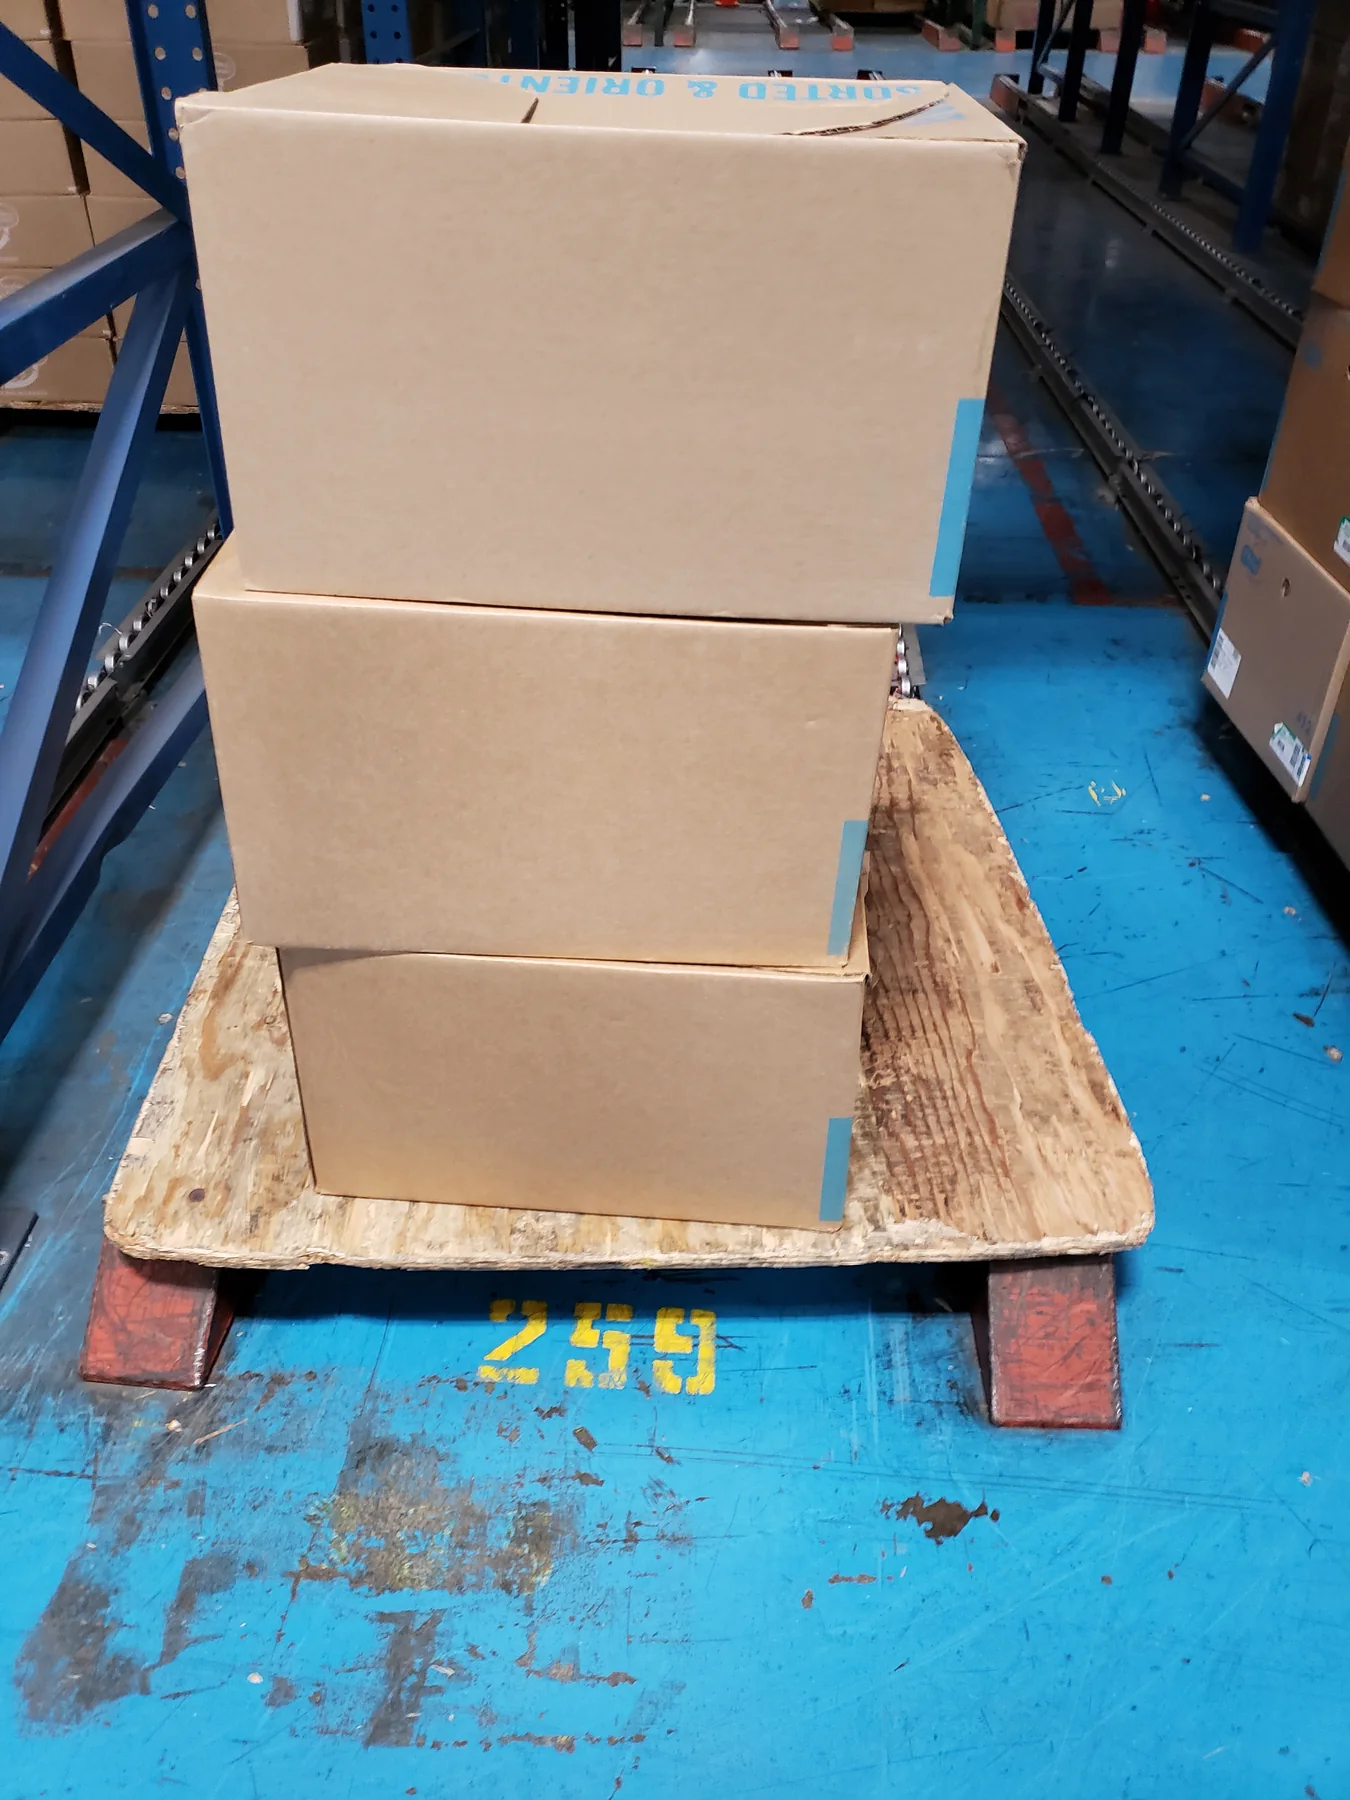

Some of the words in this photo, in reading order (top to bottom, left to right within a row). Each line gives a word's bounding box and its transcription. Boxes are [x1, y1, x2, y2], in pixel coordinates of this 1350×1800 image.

[469, 73, 665, 97] ORIEN
[687, 79, 718, 99] &
[477, 1299, 717, 1395] 259
